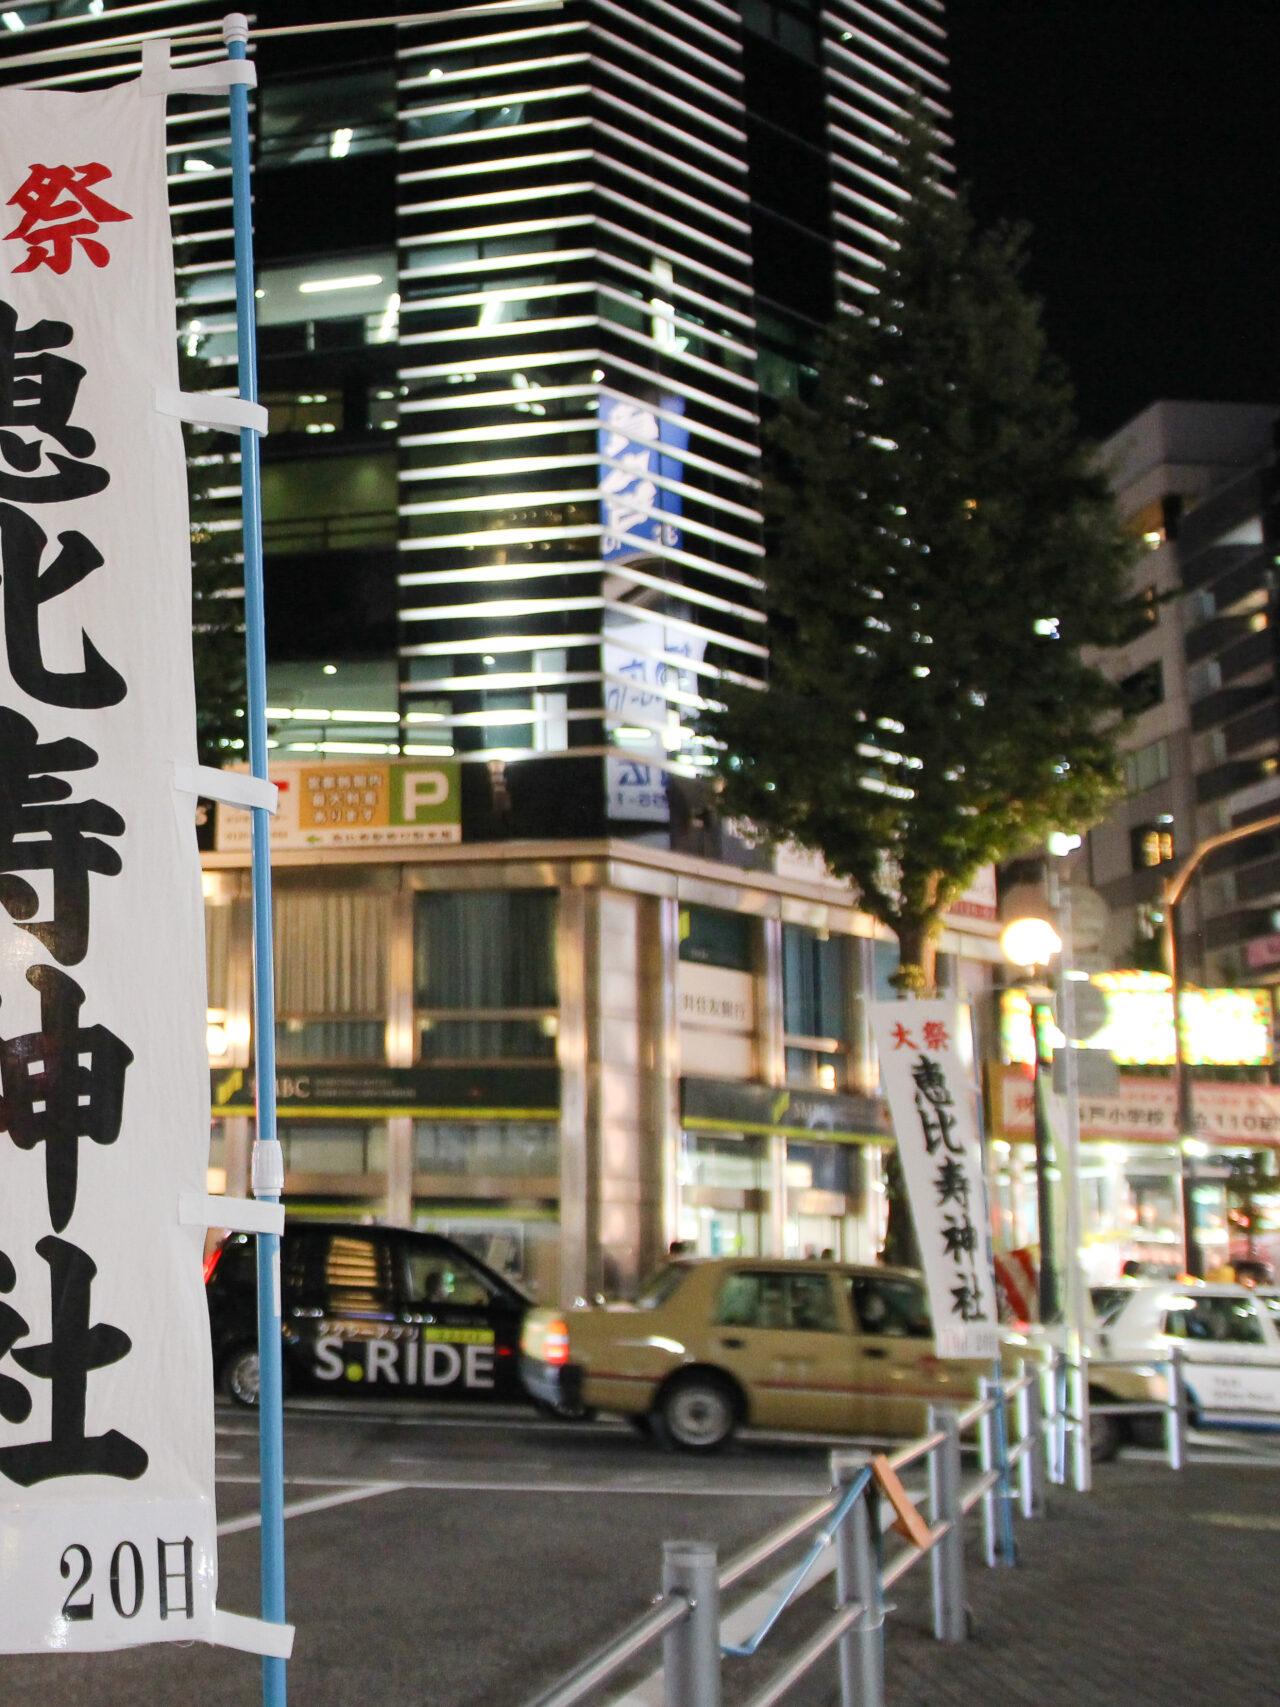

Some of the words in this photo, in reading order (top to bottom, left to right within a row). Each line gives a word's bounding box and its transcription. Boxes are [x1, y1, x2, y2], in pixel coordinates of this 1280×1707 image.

[403, 772, 449, 821] P
[680, 994, 745, 1020] 井住友銀行
[891, 1020, 950, 1051] 大祭
[1079, 1106, 1165, 1128] 戸小学校
[911, 1054, 988, 1322] 恵比寿神社
[315, 1337, 495, 1388] S.RIDE
[59, 1535, 195, 1621] 20日
